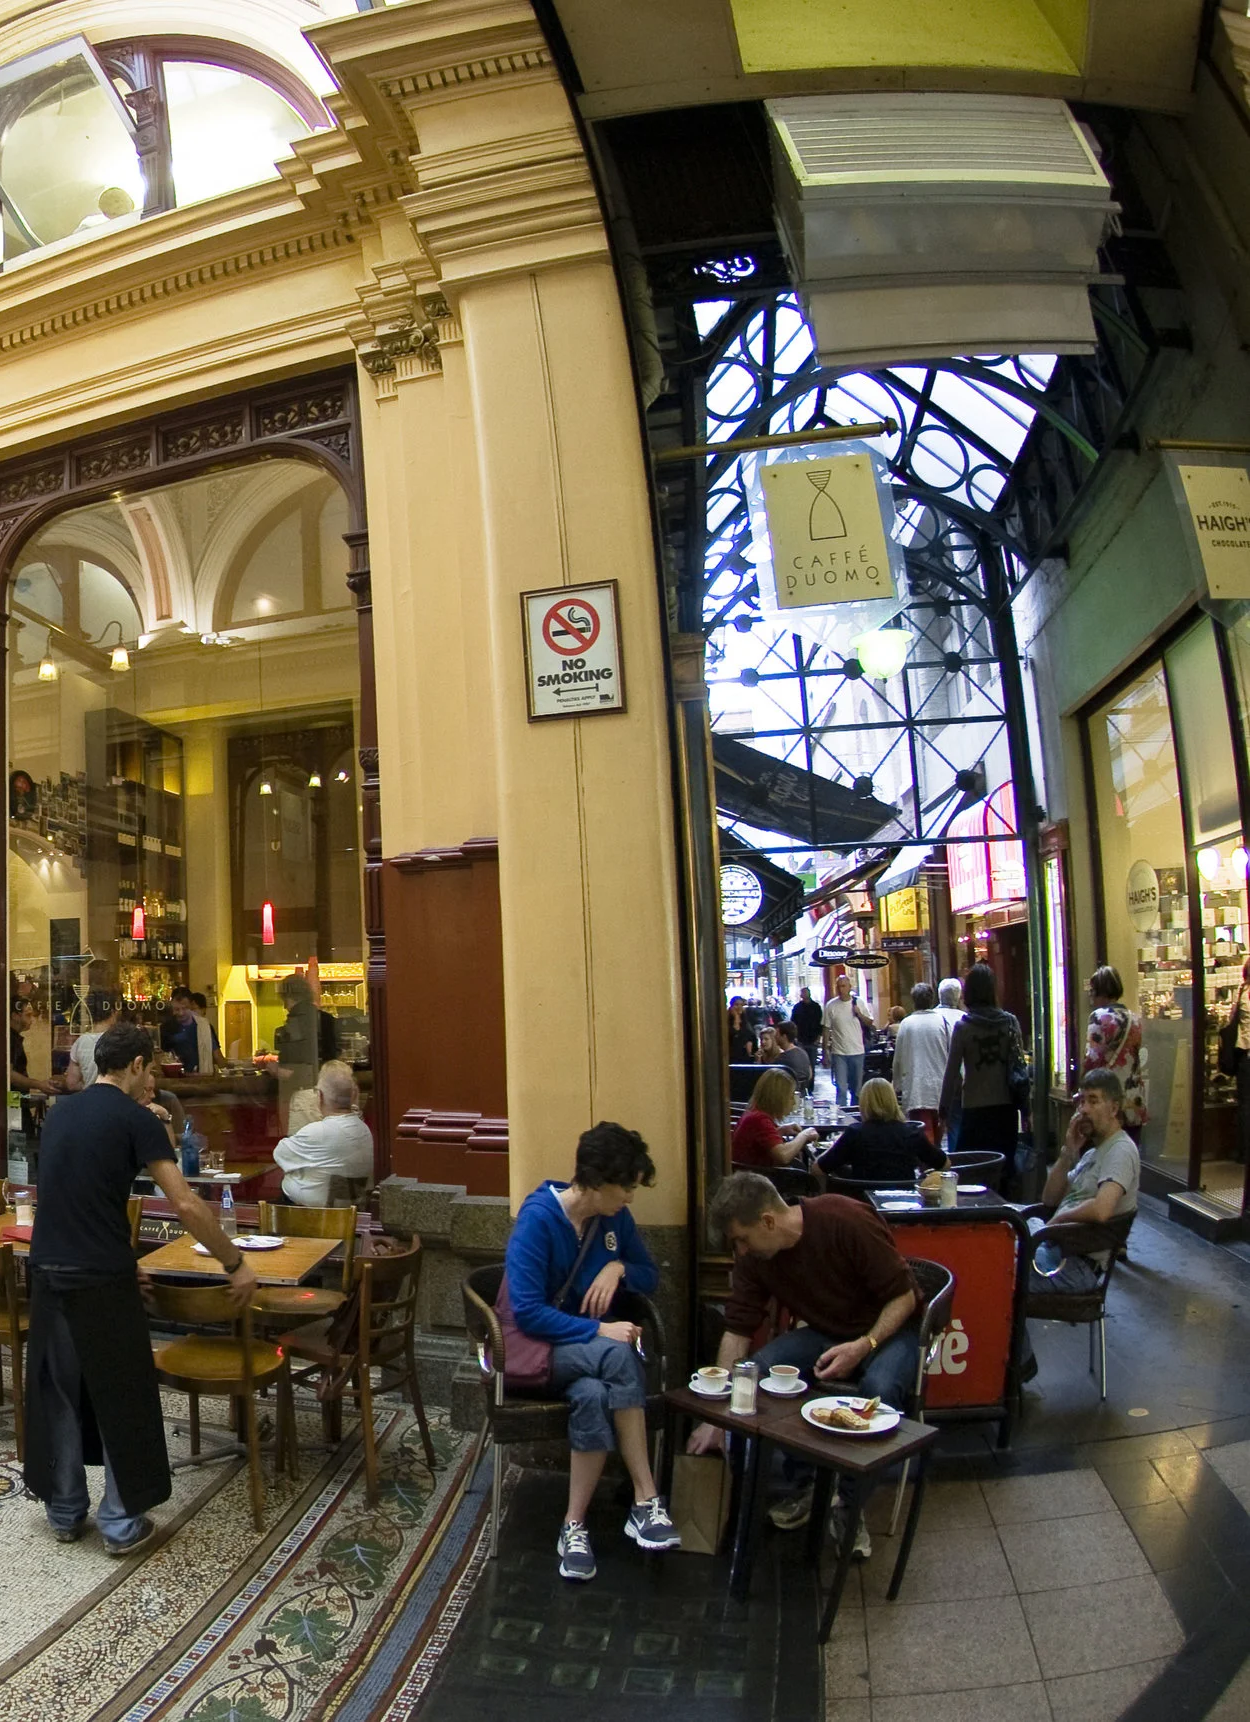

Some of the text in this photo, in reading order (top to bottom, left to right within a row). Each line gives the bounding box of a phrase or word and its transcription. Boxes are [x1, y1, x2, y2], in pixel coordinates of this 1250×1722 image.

[793, 545, 869, 570] CAFFÉ
[786, 565, 879, 588] DUOMO
[562, 658, 586, 671] NO
[537, 667, 613, 687] SMOKING
[102, 1000, 166, 1011] DUOMO
